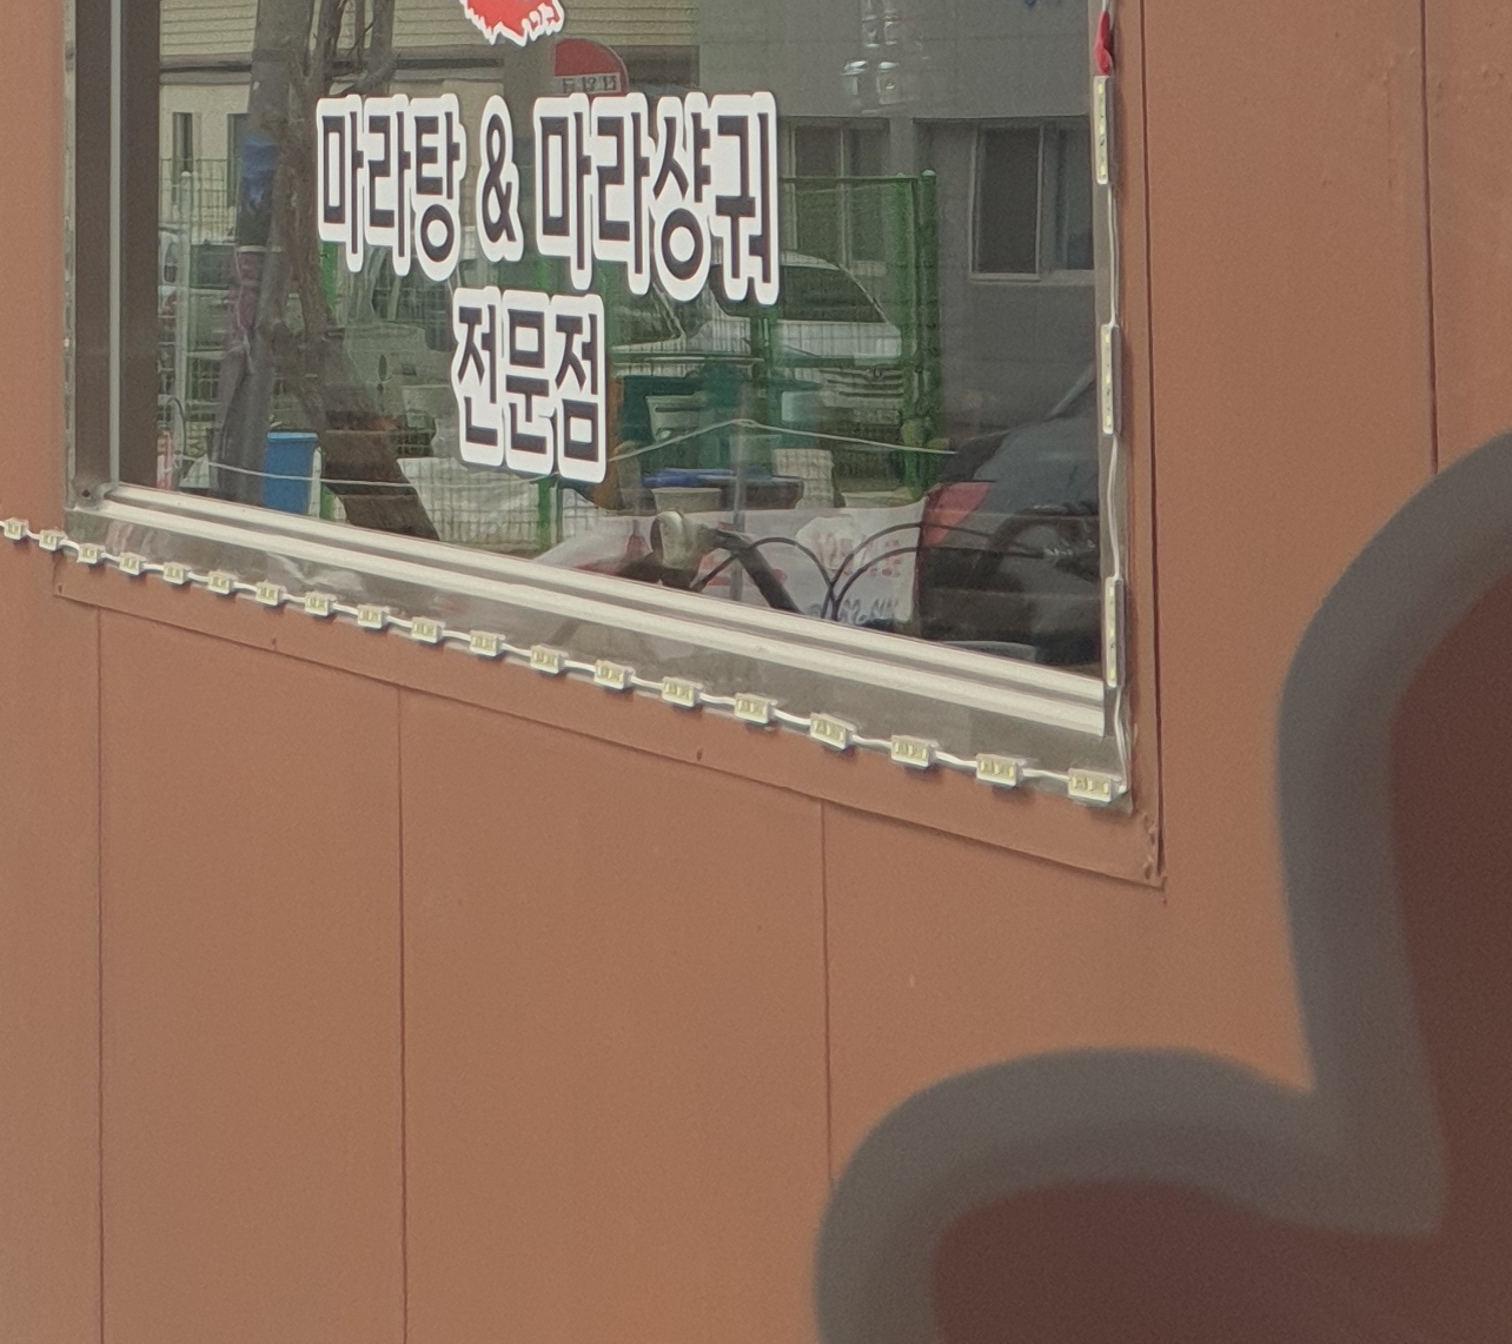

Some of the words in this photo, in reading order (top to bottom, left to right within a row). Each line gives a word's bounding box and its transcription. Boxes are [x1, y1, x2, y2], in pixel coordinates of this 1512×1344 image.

[318, 102, 464, 274] 마라탕
[478, 104, 520, 254] &
[536, 101, 775, 298] 마라샹궈
[454, 295, 602, 472] 전문점
